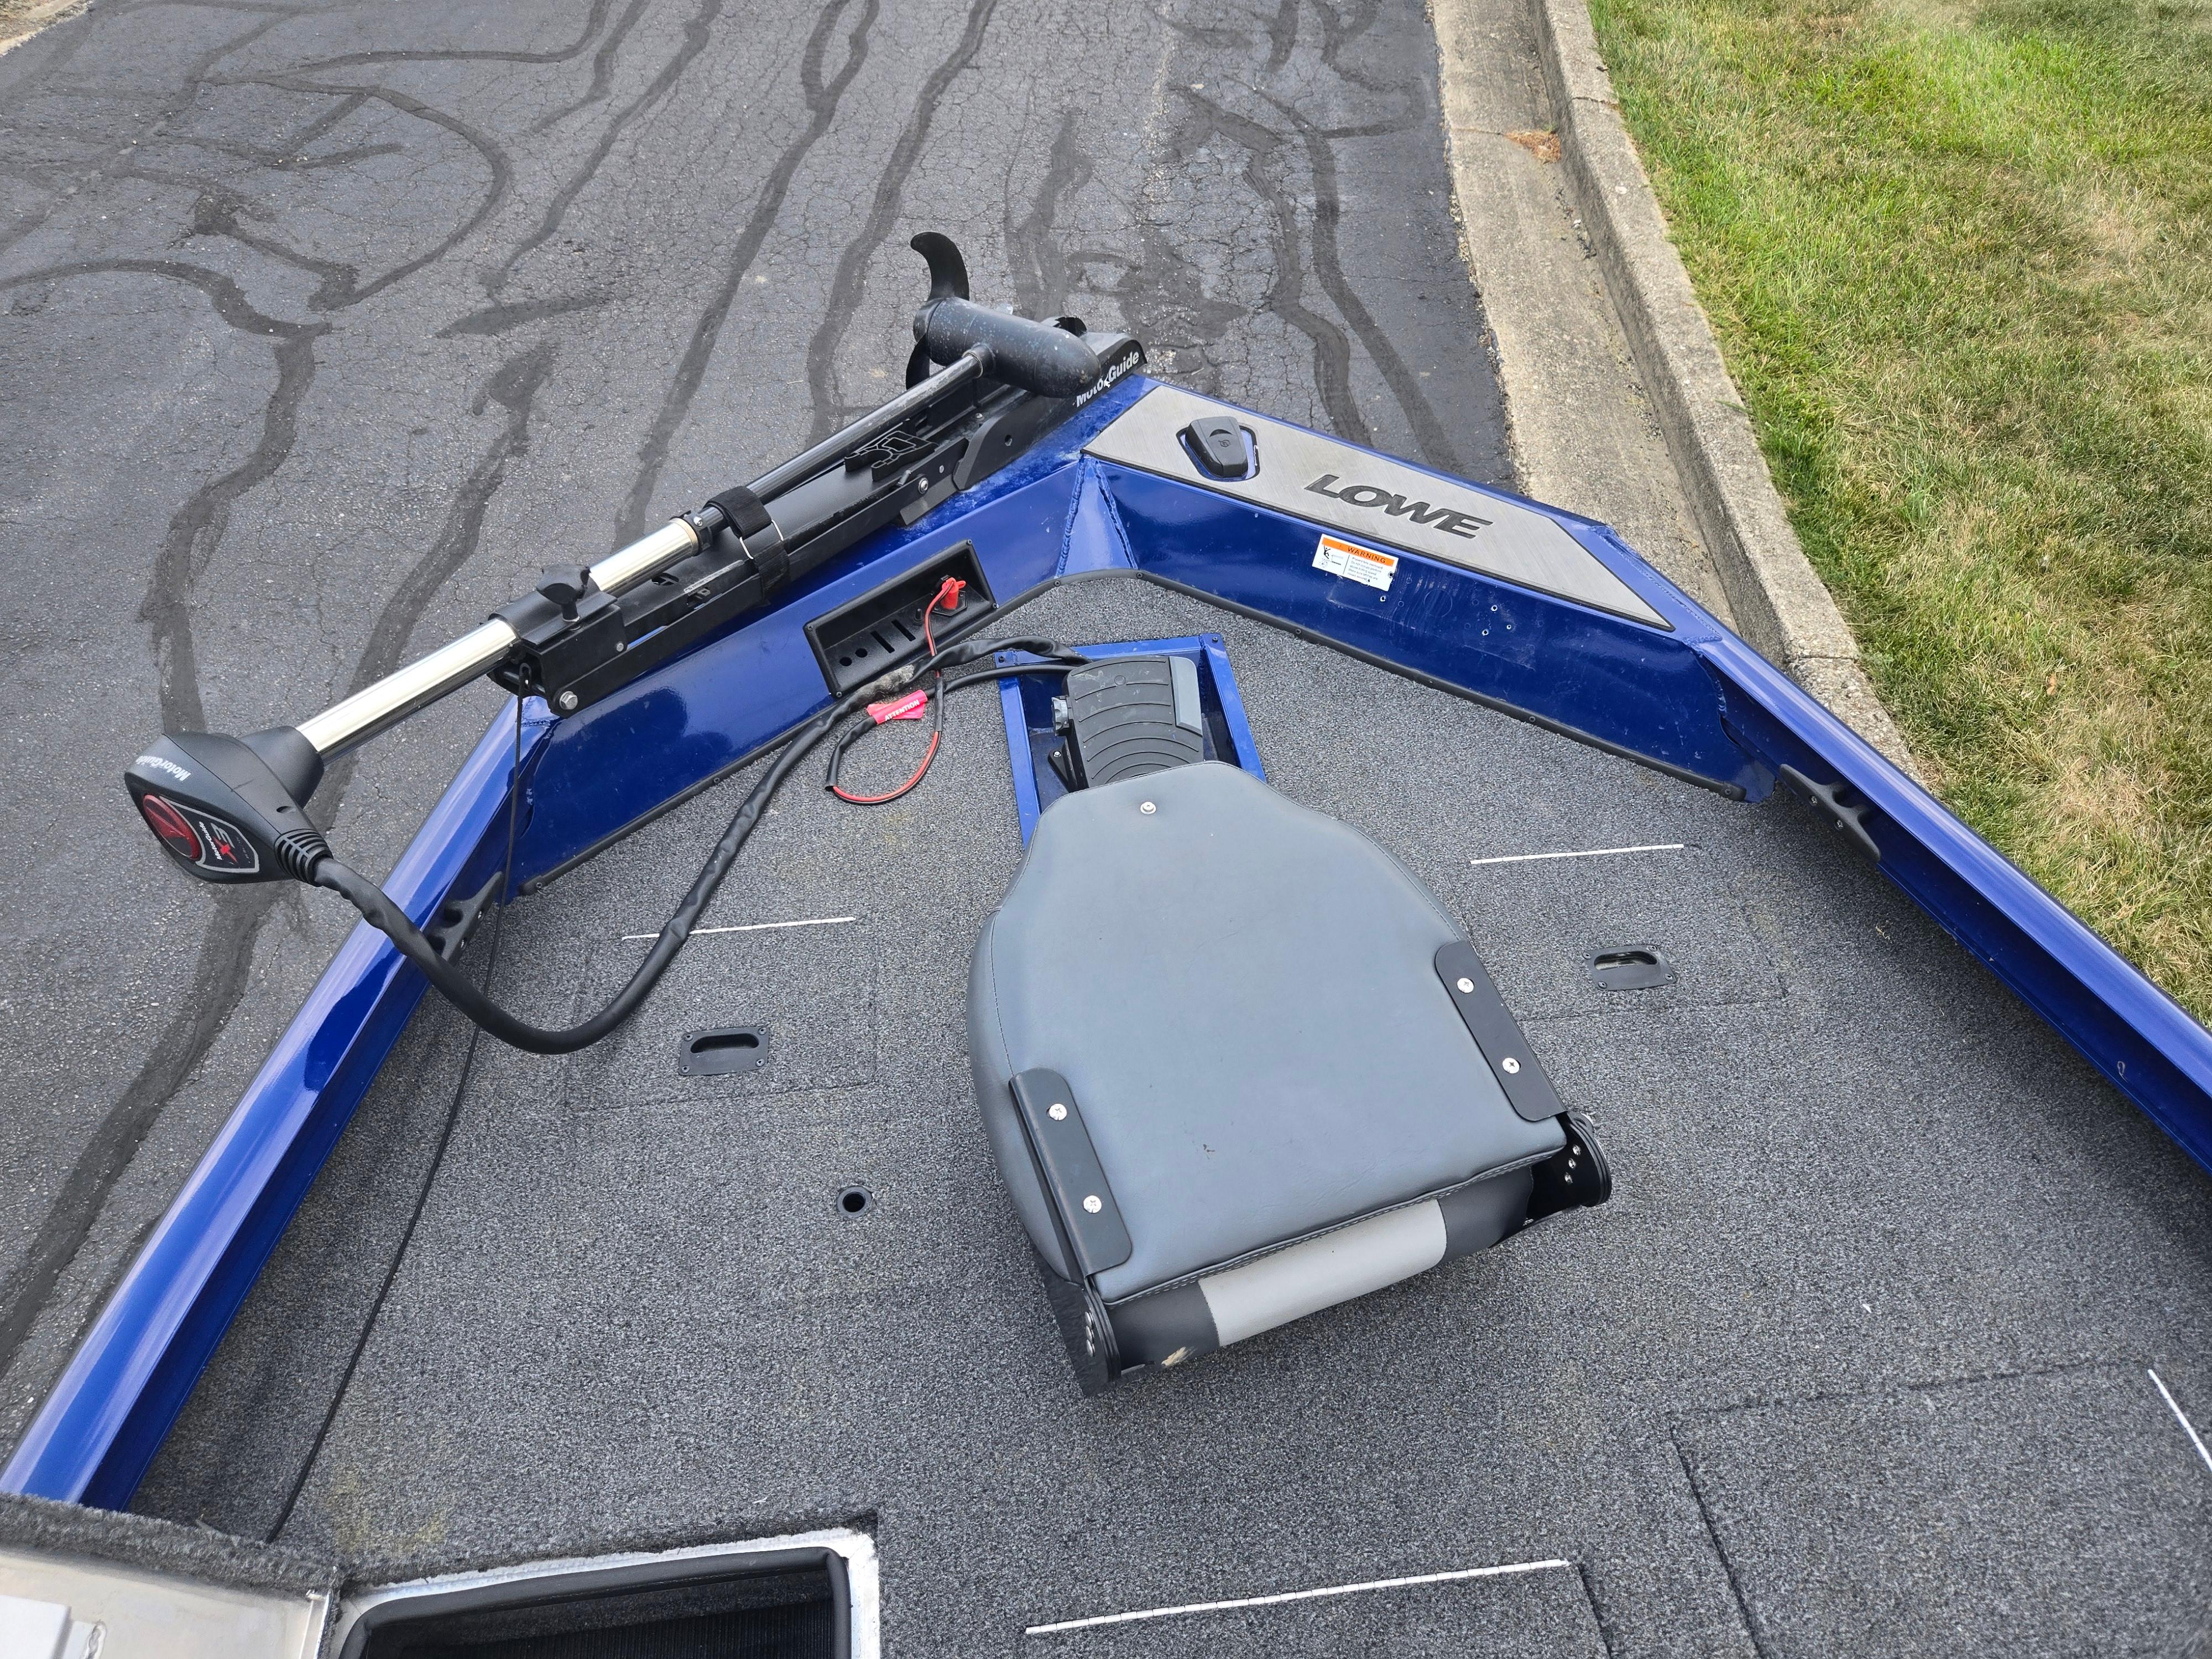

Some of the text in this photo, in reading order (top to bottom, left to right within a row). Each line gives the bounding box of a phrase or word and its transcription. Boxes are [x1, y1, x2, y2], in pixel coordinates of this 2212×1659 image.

[1305, 474, 1493, 539] LOWE
[1348, 547, 1386, 564] WARNING
[885, 700, 920, 721] ATTENTION
[135, 755, 191, 781] MotorGuide
[199, 821, 223, 860] MotorGuide
